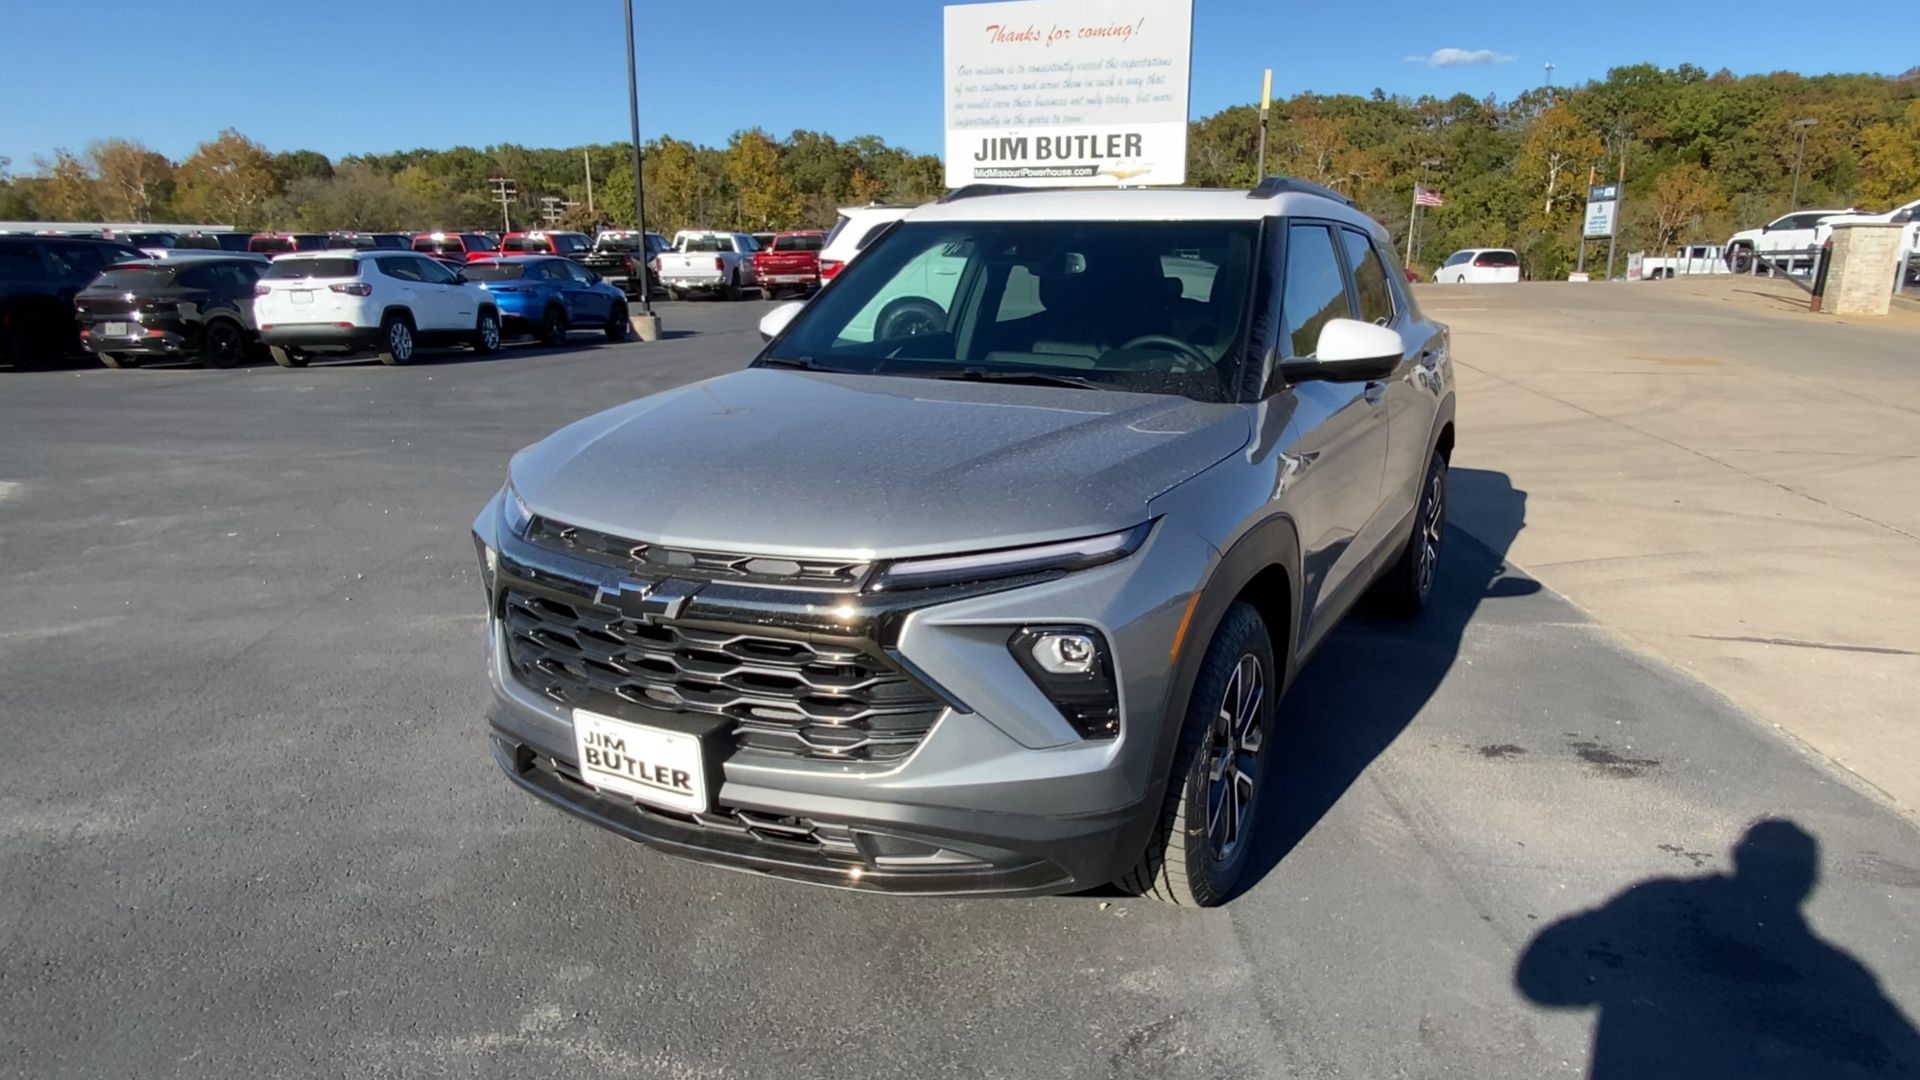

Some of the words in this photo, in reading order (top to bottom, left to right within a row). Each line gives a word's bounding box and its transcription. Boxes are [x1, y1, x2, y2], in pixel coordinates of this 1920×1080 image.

[986, 24, 1041, 44] Thanks
[1046, 24, 1071, 48] for
[1077, 17, 1145, 43] coming!
[1104, 56, 1119, 69] the
[980, 82, 1019, 92] customers
[1021, 79, 1037, 90] and
[1146, 72, 1166, 85] that
[974, 138, 1028, 161] JIM
[1036, 133, 1142, 160] BUTLER
[975, 168, 1092, 178] MidMissouriPowerhouse.com
[584, 731, 627, 753] JIM
[585, 745, 694, 791] BUTLER
